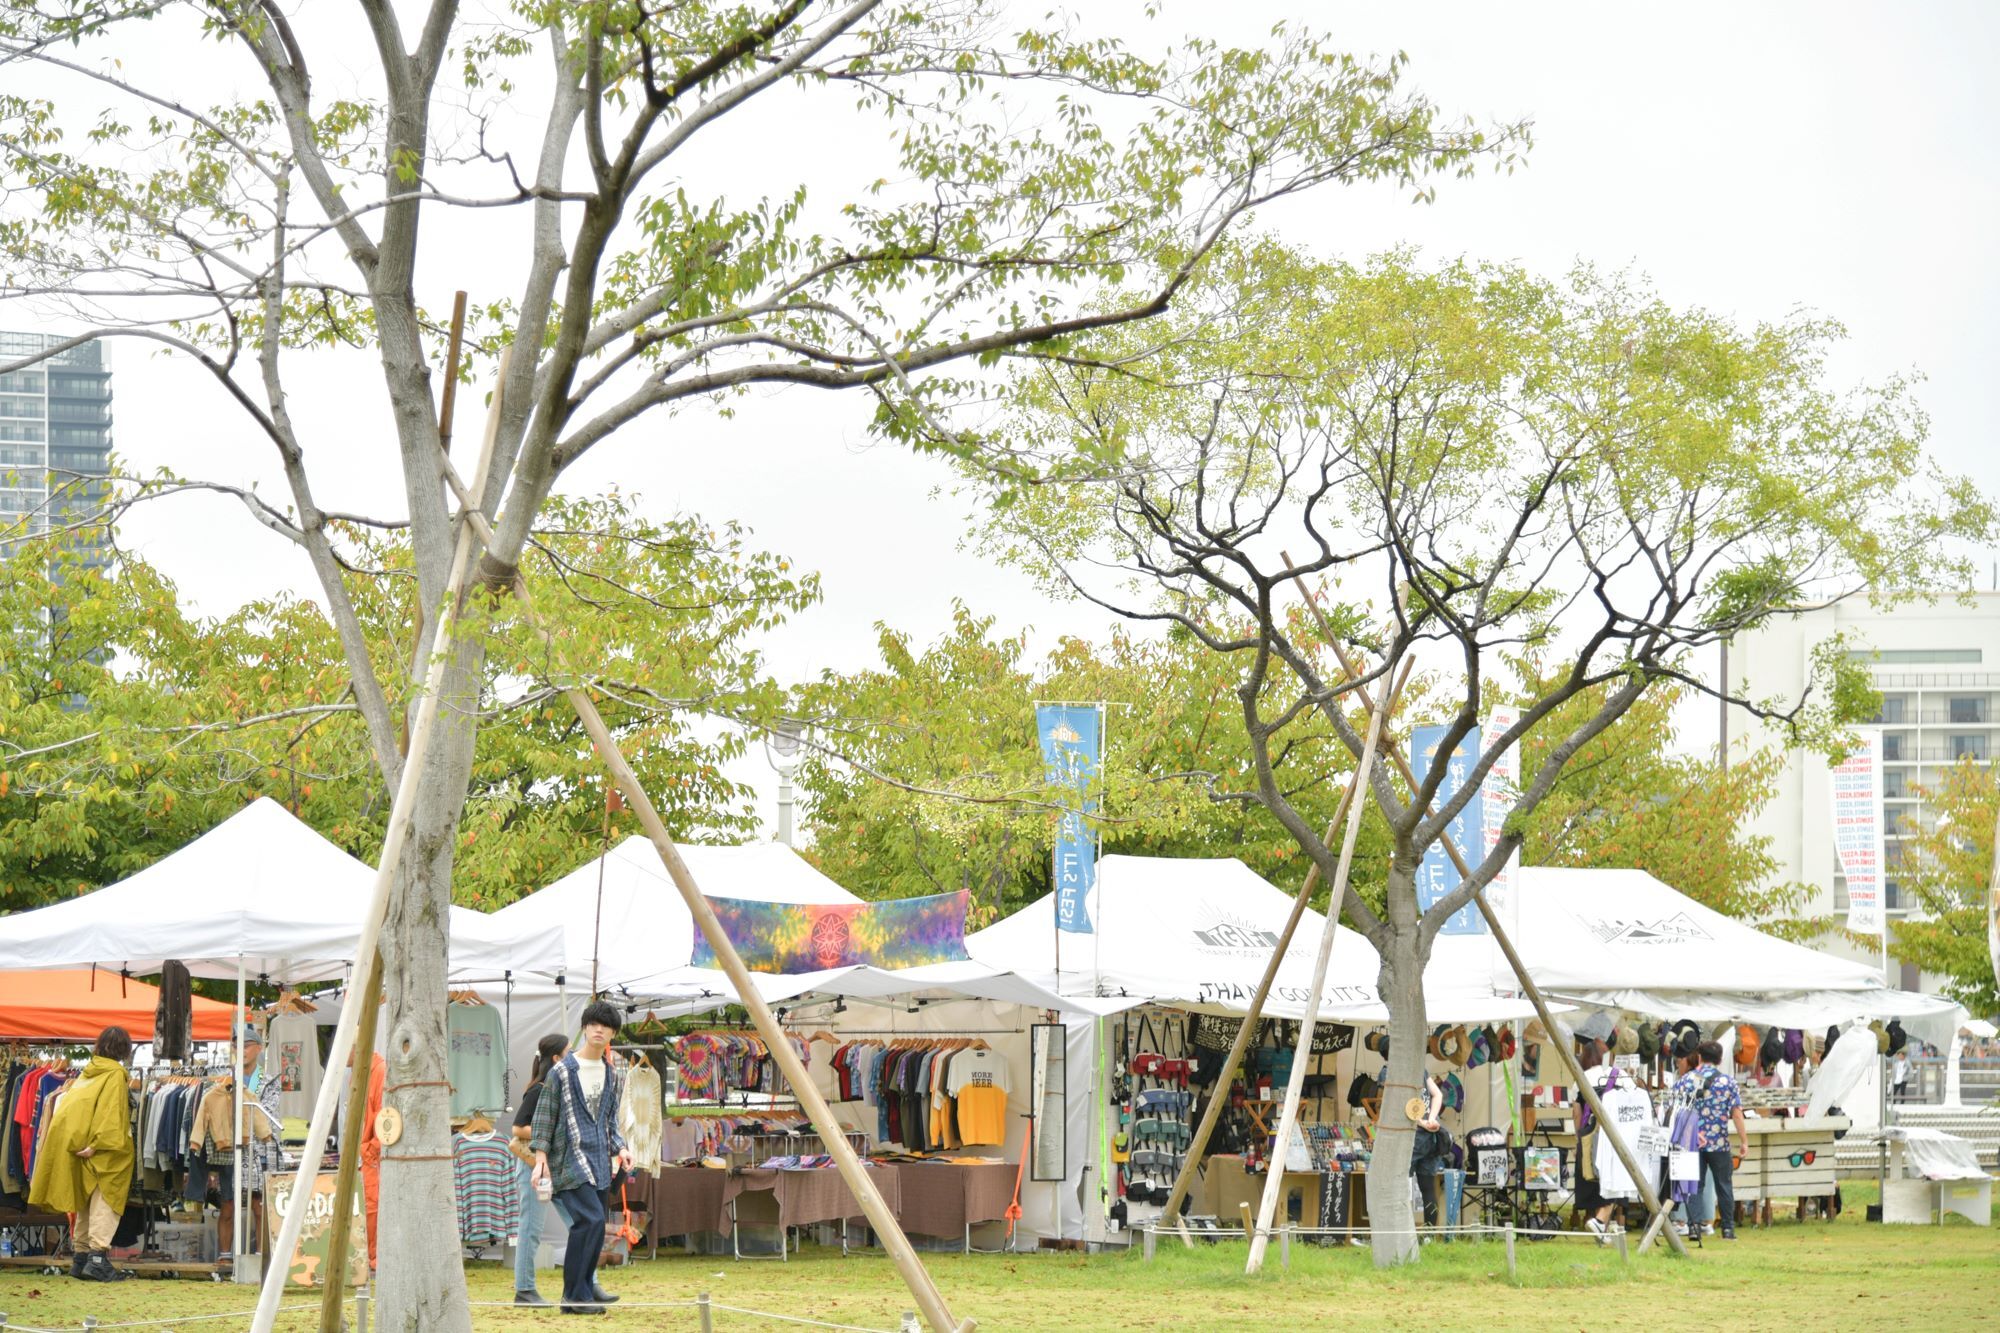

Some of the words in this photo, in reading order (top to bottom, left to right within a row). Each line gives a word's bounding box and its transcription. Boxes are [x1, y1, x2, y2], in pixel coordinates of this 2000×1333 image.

[1206, 924, 1273, 947] TGIF
[1200, 982, 1278, 1001] THAN
[1279, 986, 1333, 1005] GO,
[1332, 985, 1371, 1001] IT'S
[1482, 1155, 1506, 1168] PIZZA
